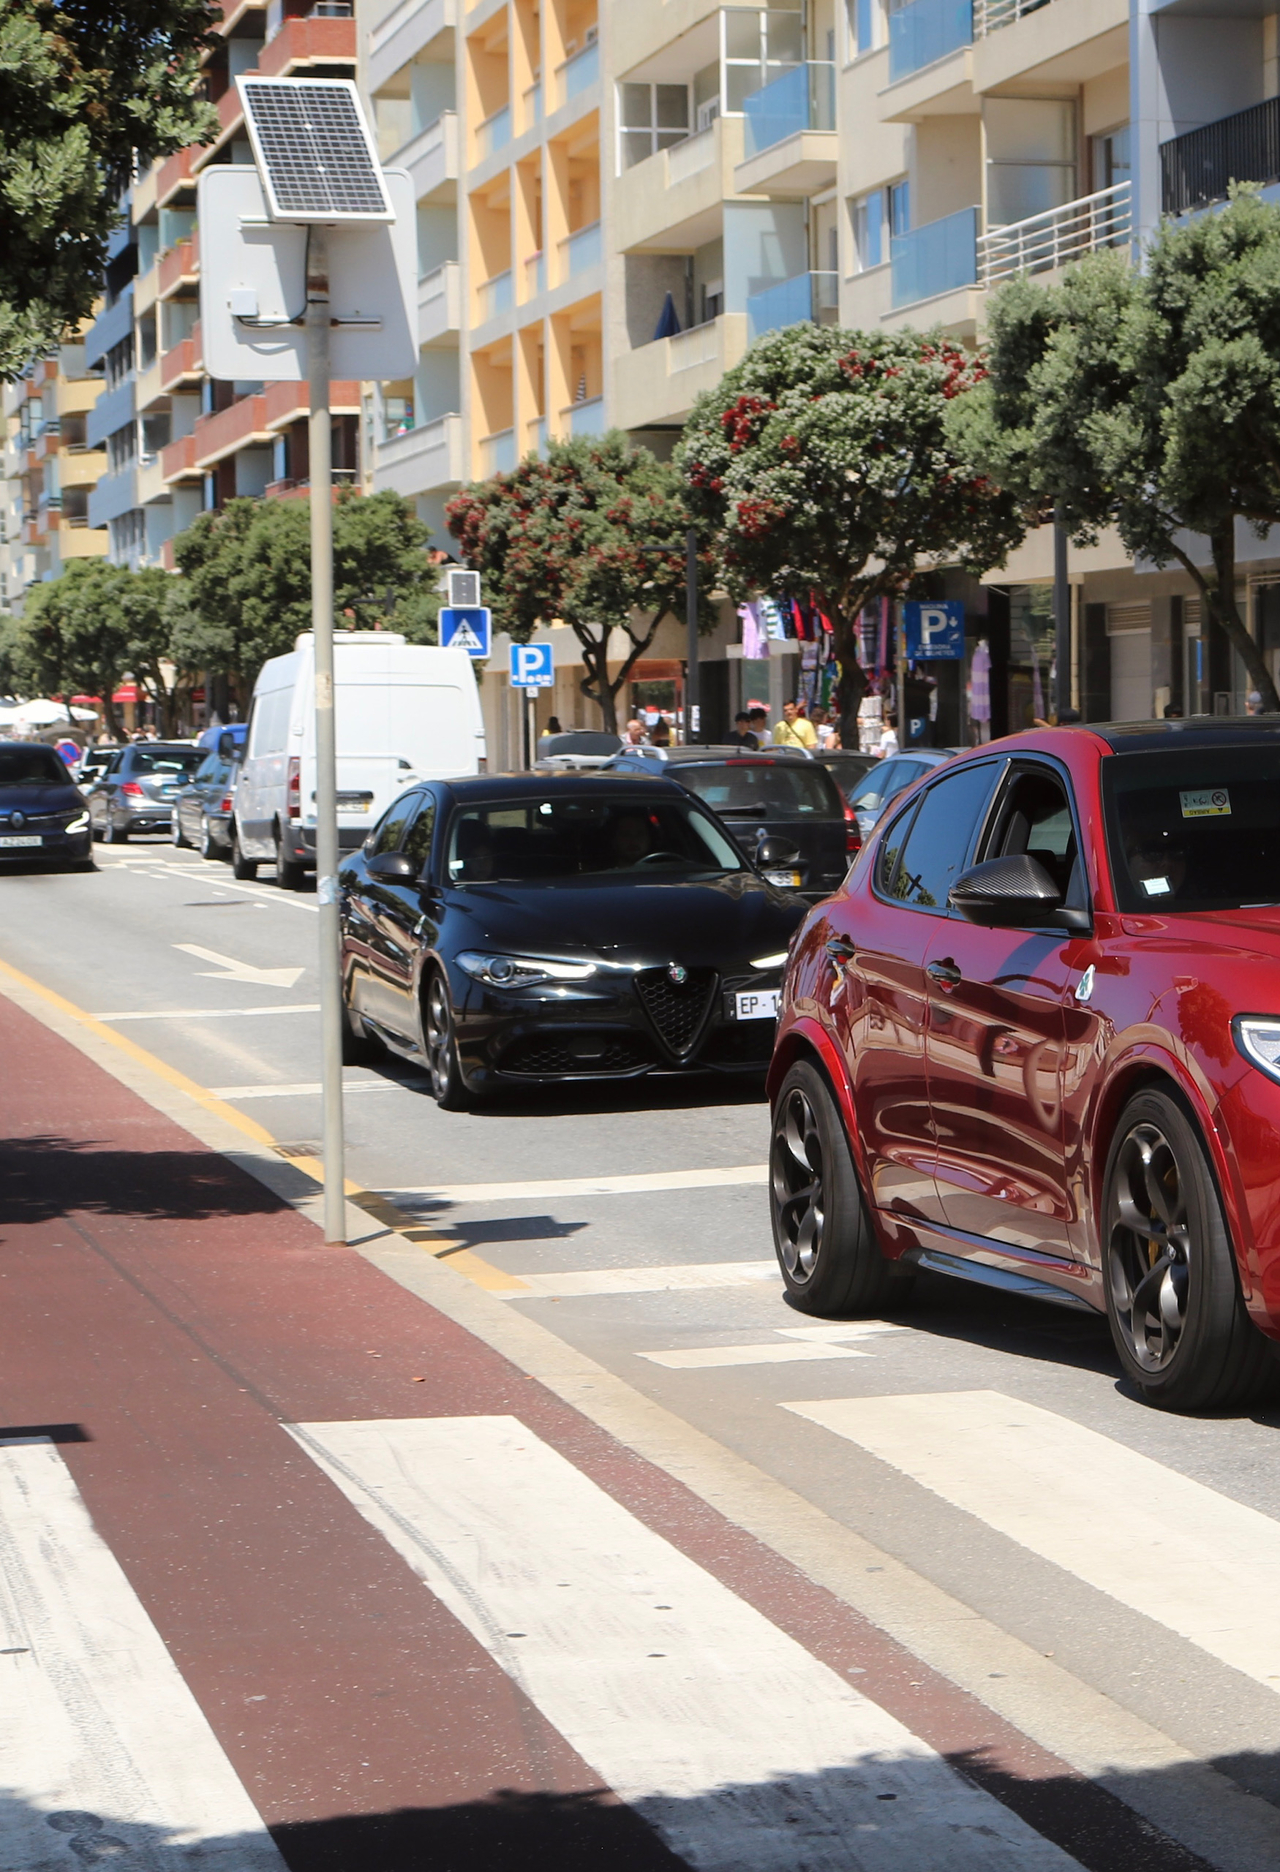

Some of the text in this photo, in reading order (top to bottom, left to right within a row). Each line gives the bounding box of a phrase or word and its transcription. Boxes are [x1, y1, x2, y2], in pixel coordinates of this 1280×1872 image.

[921, 610, 948, 645] P
[518, 647, 545, 683] P
[910, 718, 921, 734] P
